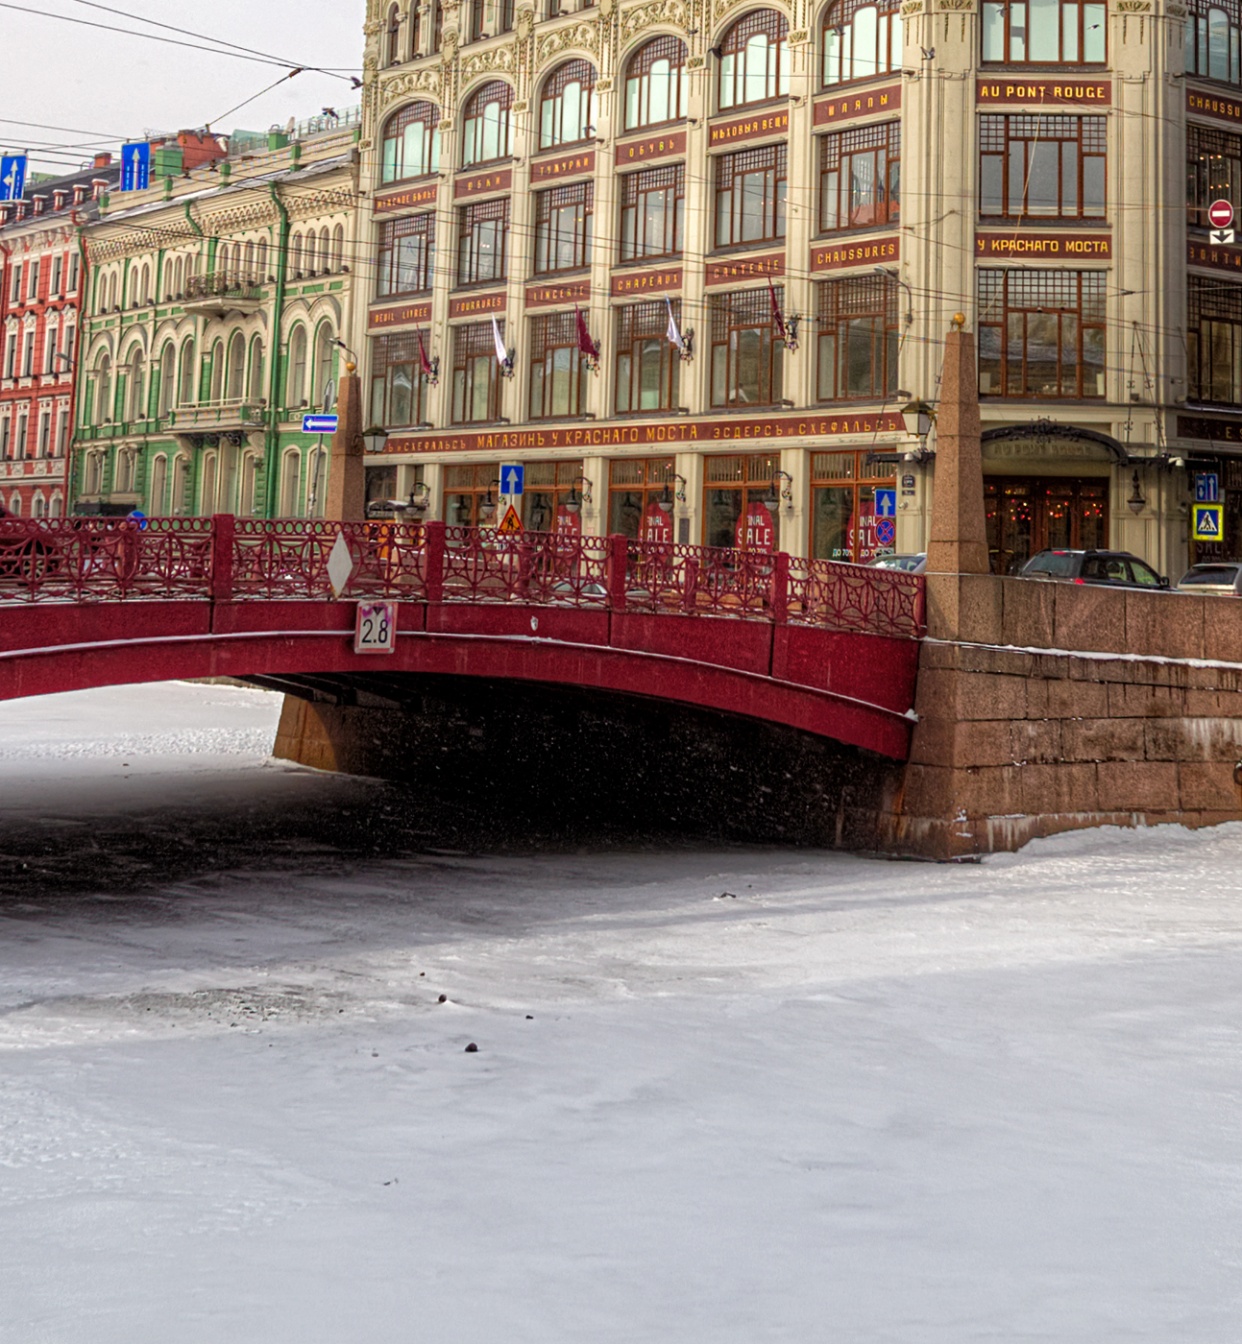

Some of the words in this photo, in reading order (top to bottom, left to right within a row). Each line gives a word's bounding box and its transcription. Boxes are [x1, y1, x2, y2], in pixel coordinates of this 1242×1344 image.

[981, 86, 1000, 97] AU
[1006, 86, 1046, 98] PONT
[1053, 86, 1105, 99] ROUGE
[828, 94, 888, 117] ШЛЯПЫ
[762, 115, 788, 131] ВЕЩИ
[629, 139, 675, 158] ОБУВЬ
[817, 243, 895, 265] CHAUSSURES
[977, 239, 985, 251] У
[991, 239, 1059, 252] КРАСНАГО
[1065, 240, 1109, 253] МОСТА
[617, 272, 679, 291] CHAPEAUX
[476, 431, 545, 448] МАГАЗИНЪ
[552, 432, 559, 446] У
[565, 427, 639, 445] КРАСНАГО
[646, 425, 698, 441] МОСТА
[798, 418, 896, 435] СХЕФАЛЬСЪ
[737, 528, 771, 545] SALE
[361, 619, 389, 644] 2.8
